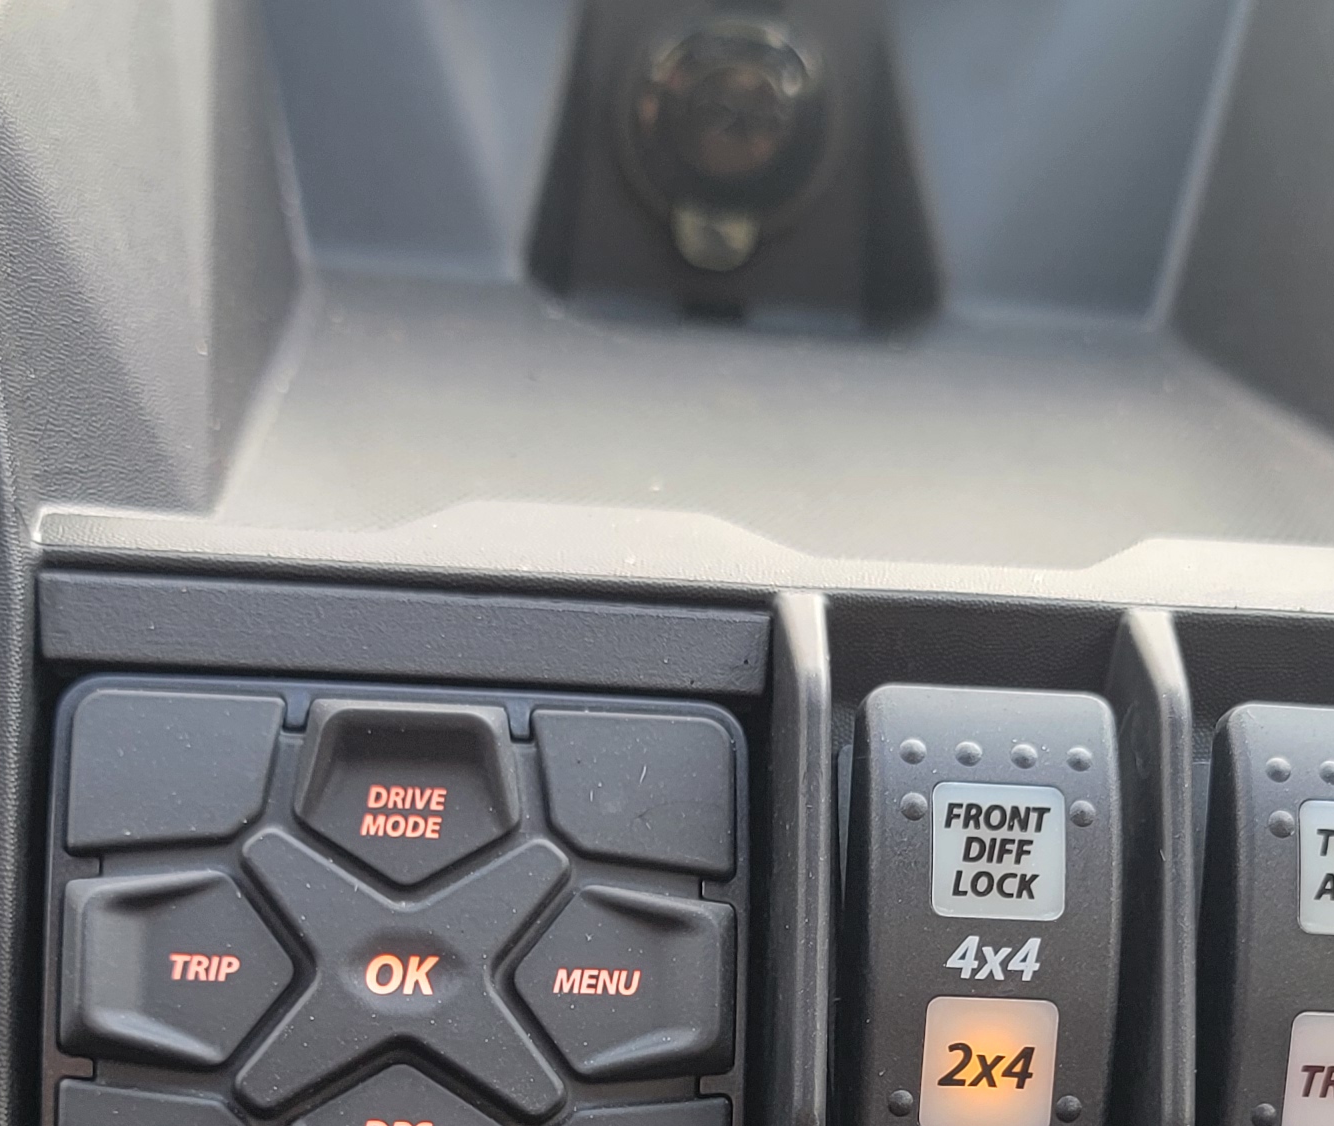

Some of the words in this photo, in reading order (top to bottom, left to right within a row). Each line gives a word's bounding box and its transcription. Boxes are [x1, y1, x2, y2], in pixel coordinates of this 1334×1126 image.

[366, 785, 447, 811] DRIVE
[360, 815, 442, 839] MODE
[943, 803, 1051, 833] FRONT
[962, 837, 1034, 864] DIFF
[951, 869, 1038, 899] LOCK
[169, 953, 240, 982] TRIP
[945, 936, 1041, 981] 4x4
[365, 954, 439, 995] OK
[553, 968, 641, 996] MENU
[937, 1043, 1035, 1089] 2x4
